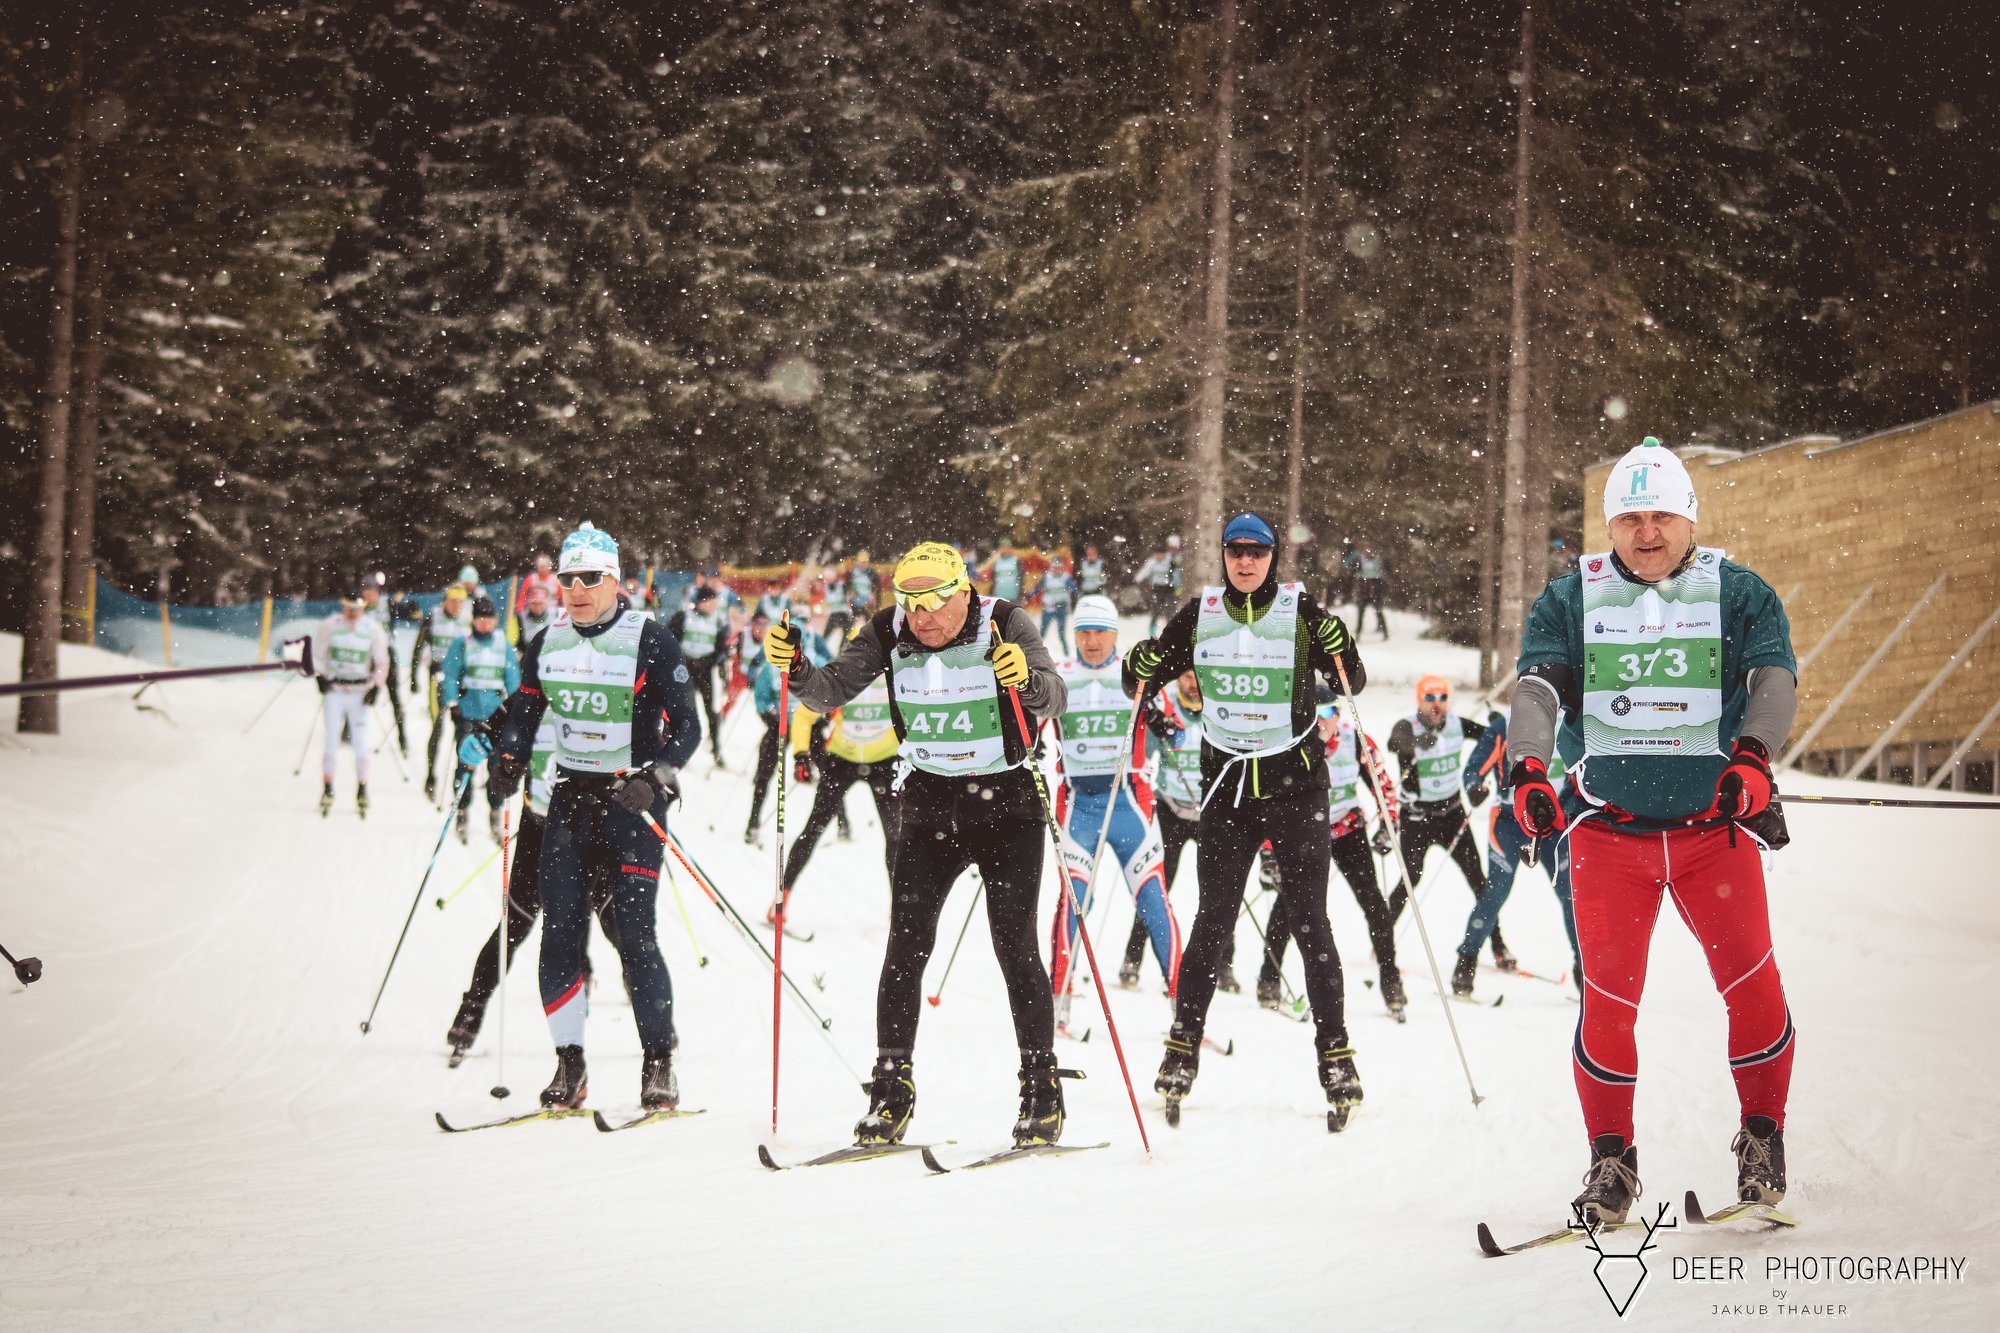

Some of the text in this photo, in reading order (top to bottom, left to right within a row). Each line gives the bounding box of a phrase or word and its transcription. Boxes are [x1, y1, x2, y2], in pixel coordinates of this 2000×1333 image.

[1631, 467, 1648, 495] H
[1617, 648, 1688, 682] 373
[1215, 673, 1269, 697] 389
[558, 689, 608, 715] 379
[853, 706, 882, 719] 457
[910, 709, 973, 734] 474
[1076, 715, 1118, 734] 375
[1030, 760, 1047, 798] LEKI
[1133, 843, 1161, 875] CZE
